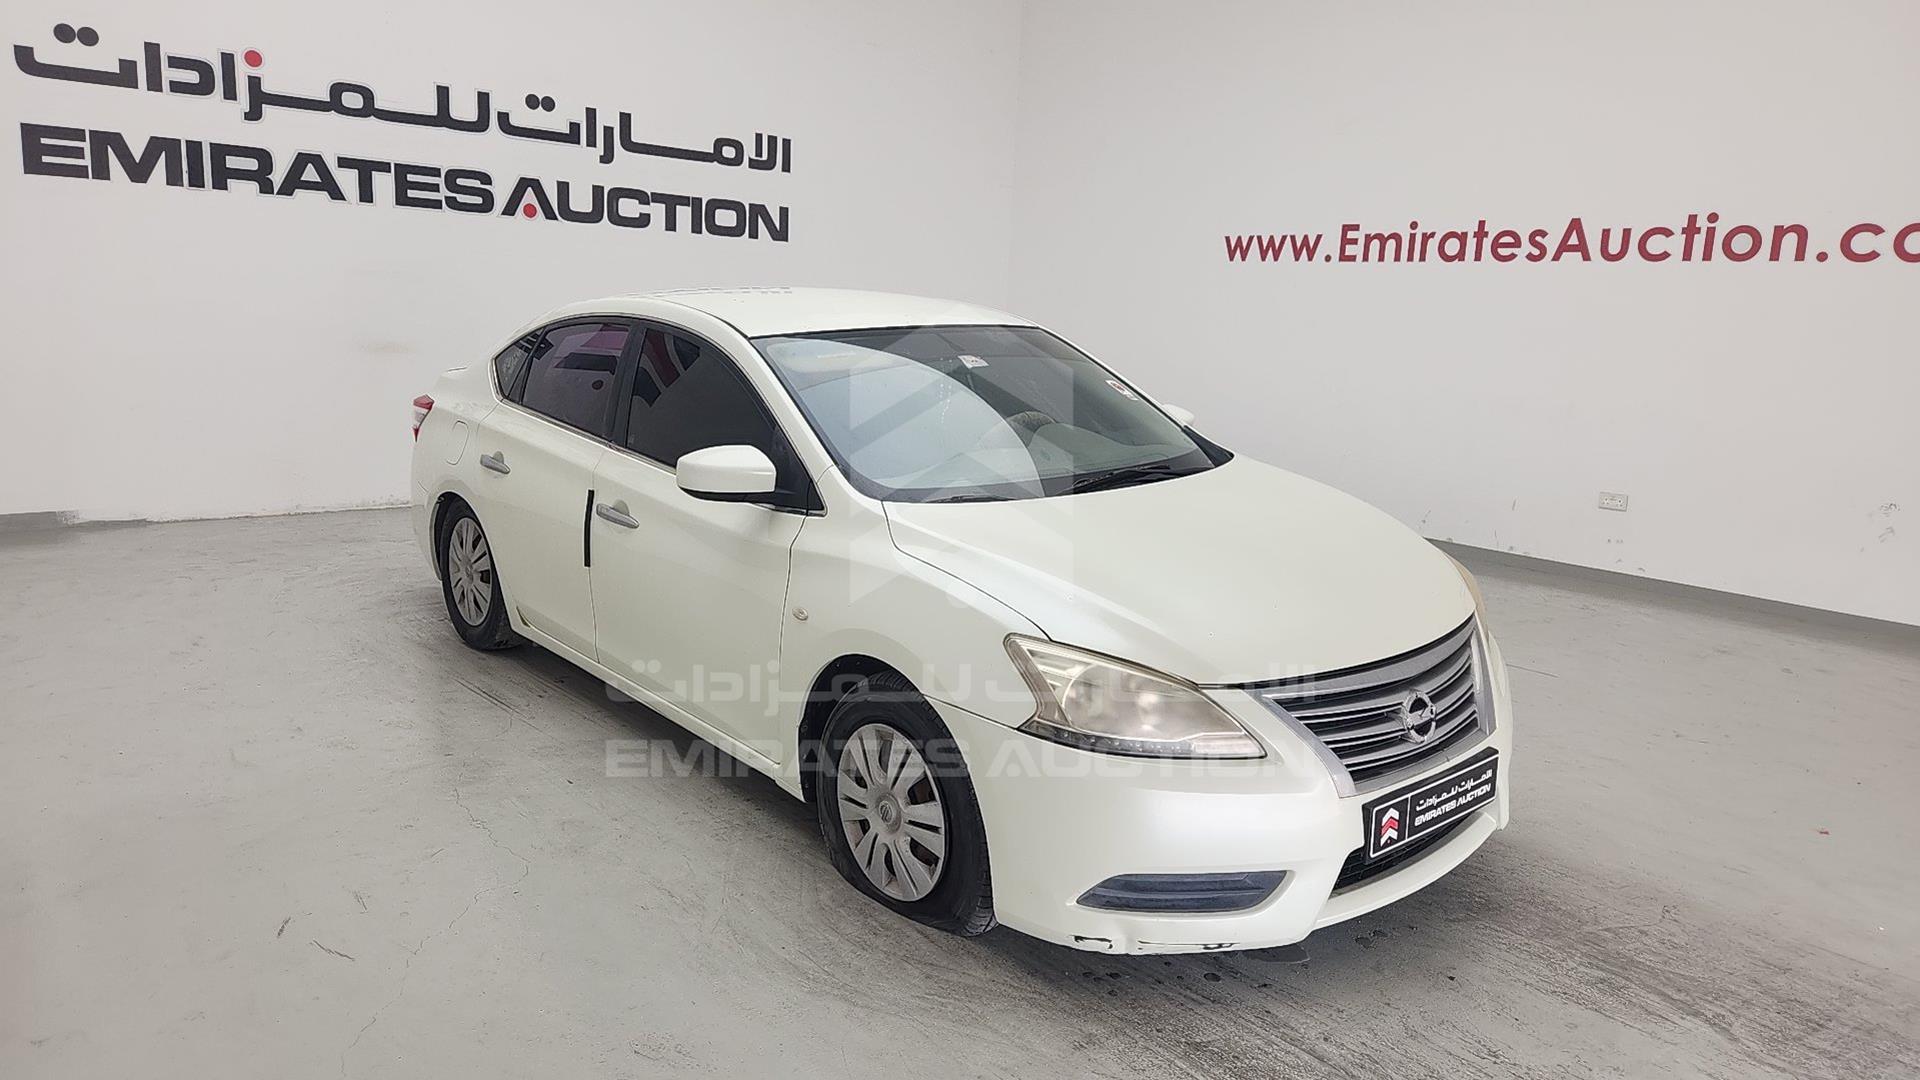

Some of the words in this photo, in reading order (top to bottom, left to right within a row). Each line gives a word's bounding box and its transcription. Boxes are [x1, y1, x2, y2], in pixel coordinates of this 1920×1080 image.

[14, 24, 491, 132] للمزادات
[497, 94, 792, 173] الامارات
[20, 123, 495, 213] EMIRATES
[501, 177, 789, 242] AUCTION
[1414, 799, 1457, 826] EMIRATES
[1457, 783, 1491, 807] AUCTION
